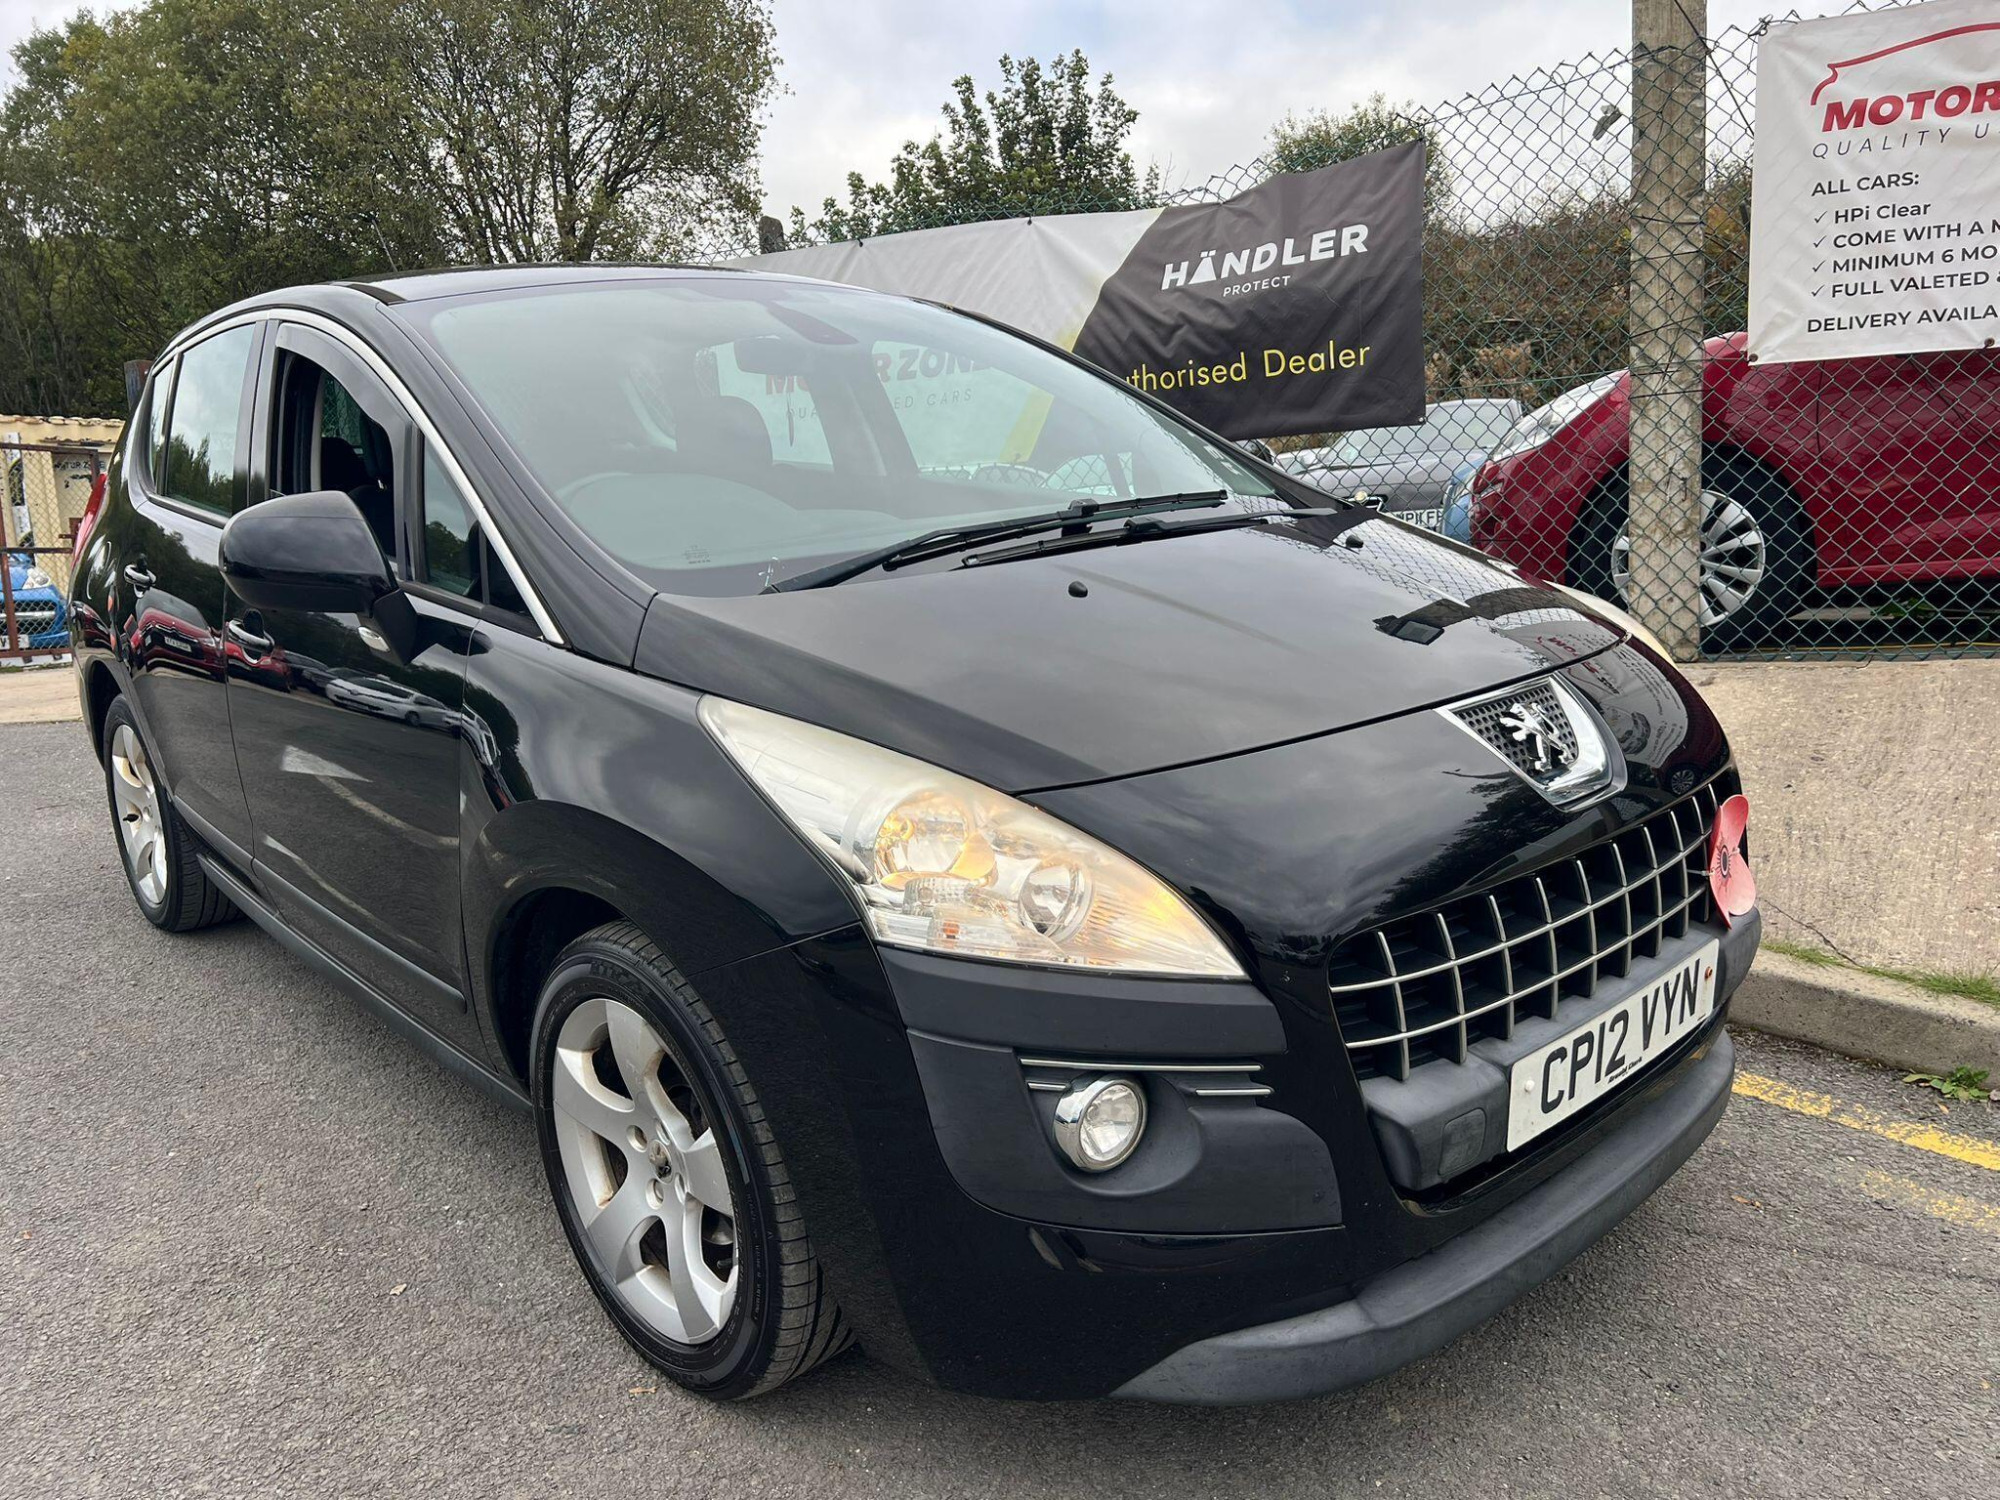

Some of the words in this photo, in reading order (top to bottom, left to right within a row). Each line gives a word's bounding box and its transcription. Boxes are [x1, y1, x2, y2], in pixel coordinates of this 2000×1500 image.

[1812, 127, 1951, 159] QUALITY
[1811, 178, 1850, 197] ALL
[1856, 172, 1920, 191] CARS:
[1834, 205, 1870, 224] HPi
[1876, 201, 1931, 220] Clear
[1833, 229, 1897, 248] COME
[1903, 222, 1961, 241] WITH
[1968, 221, 1984, 235] A
[1161, 223, 1369, 291] HÄNDLER
[1832, 250, 1934, 274] MINIMUM
[1941, 249, 1954, 263] 6
[1223, 275, 1291, 297] PROTECT
[1831, 280, 1883, 298] FULL
[1890, 271, 1989, 293] VALETED
[1807, 310, 1912, 333] DELIVERY
[1126, 352, 1247, 391] thorised
[1264, 340, 1371, 378] Dealer
[927, 388, 972, 406] CARS
[1541, 1009, 1629, 1114] CP12
[1642, 958, 1700, 1051] VYN
